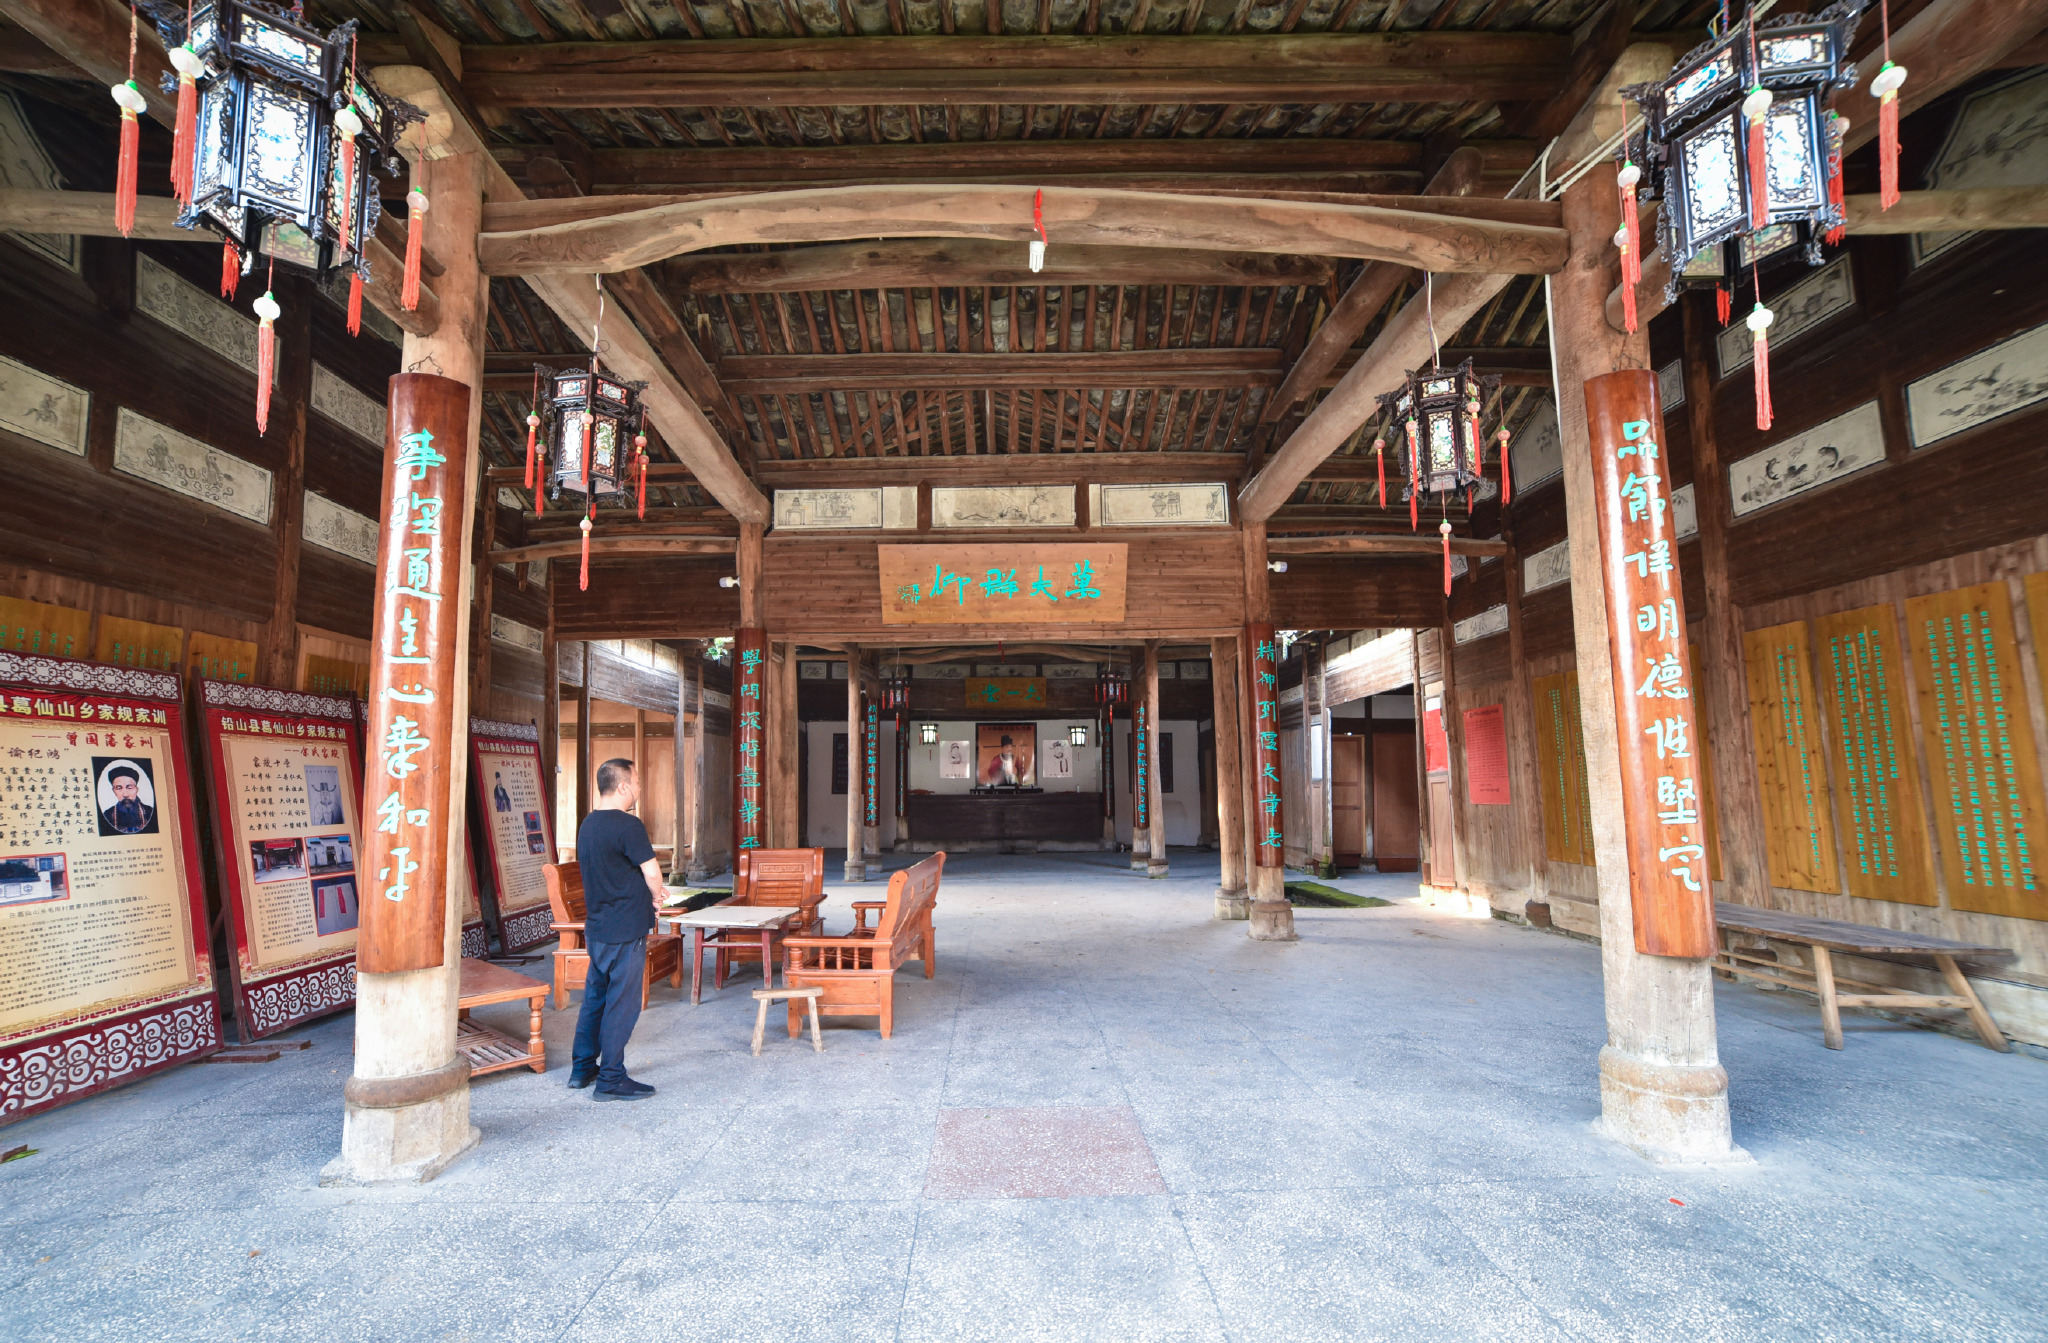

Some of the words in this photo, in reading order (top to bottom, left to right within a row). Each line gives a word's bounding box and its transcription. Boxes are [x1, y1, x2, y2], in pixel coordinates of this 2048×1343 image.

[221, 716, 347, 740] 铅山县葛仙山乡家规家训
